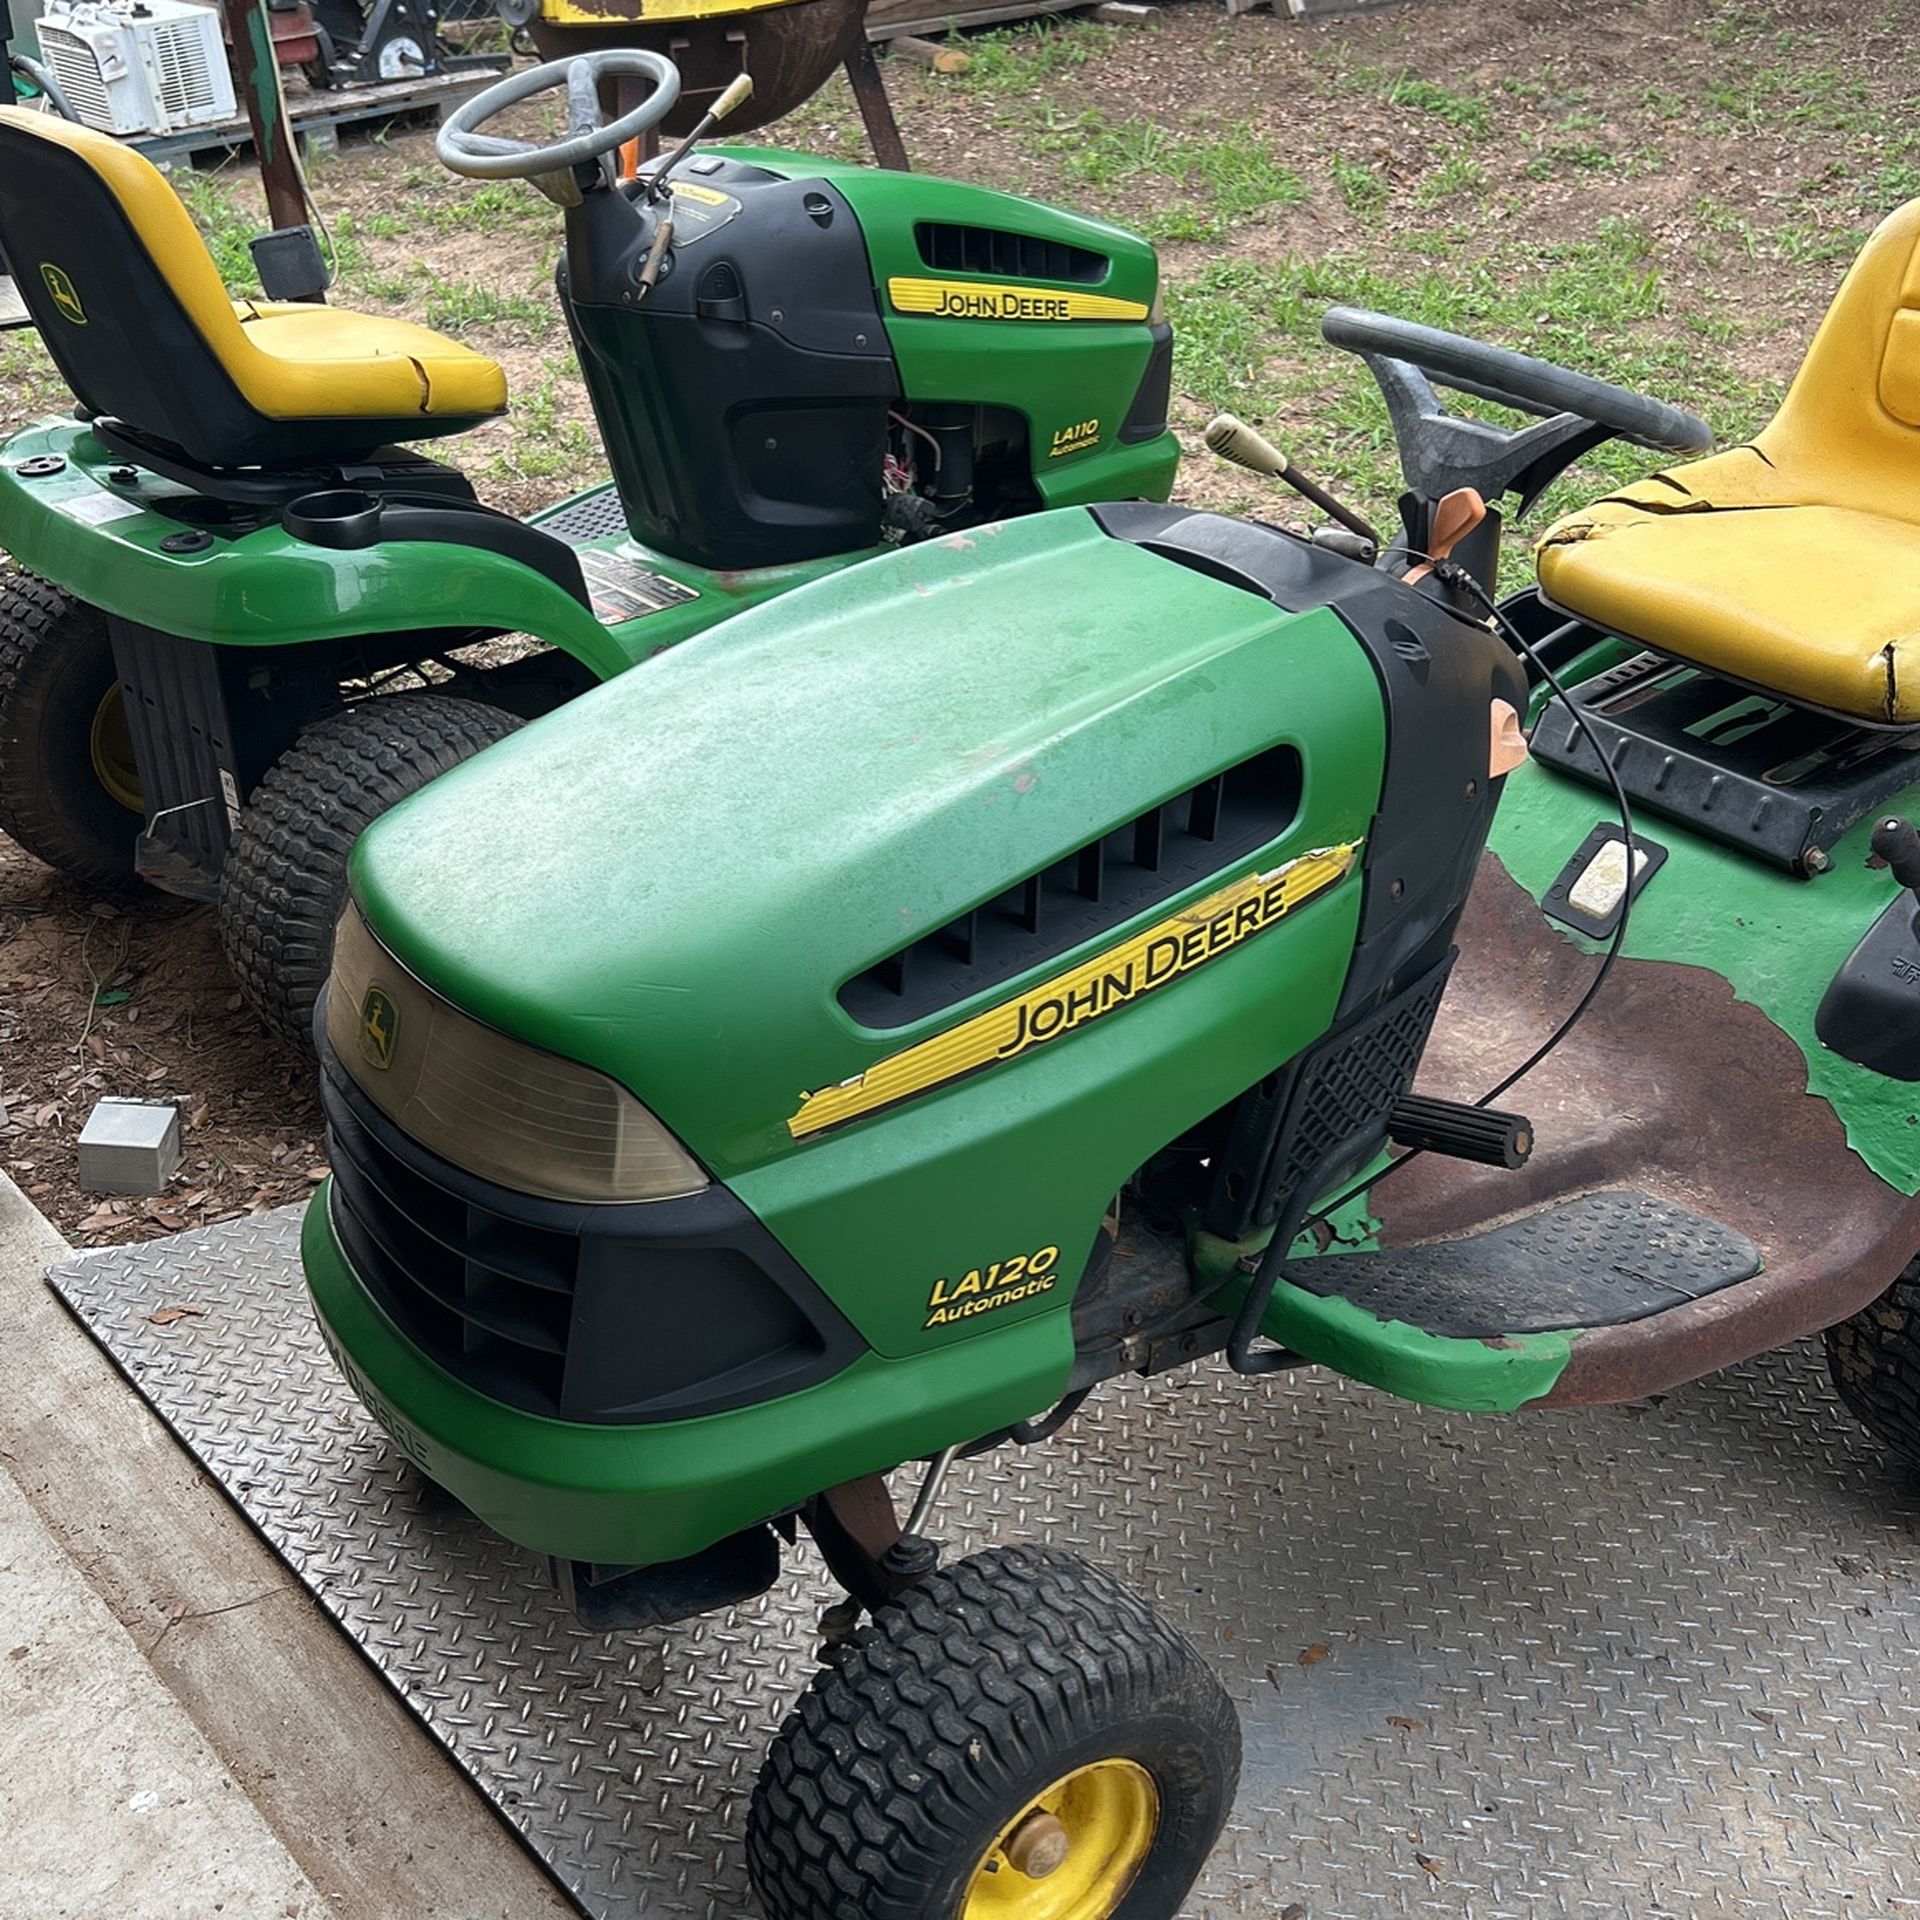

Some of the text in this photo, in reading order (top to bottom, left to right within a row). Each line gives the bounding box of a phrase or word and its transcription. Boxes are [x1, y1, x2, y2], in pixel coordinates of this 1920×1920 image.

[934, 290, 1069, 318] JOHN DEERE
[1052, 418, 1099, 446] LA110
[998, 879, 1289, 1060] JOHN DEERE
[924, 1274, 1057, 1329] Automatic
[928, 1244, 1060, 1309] LA120
